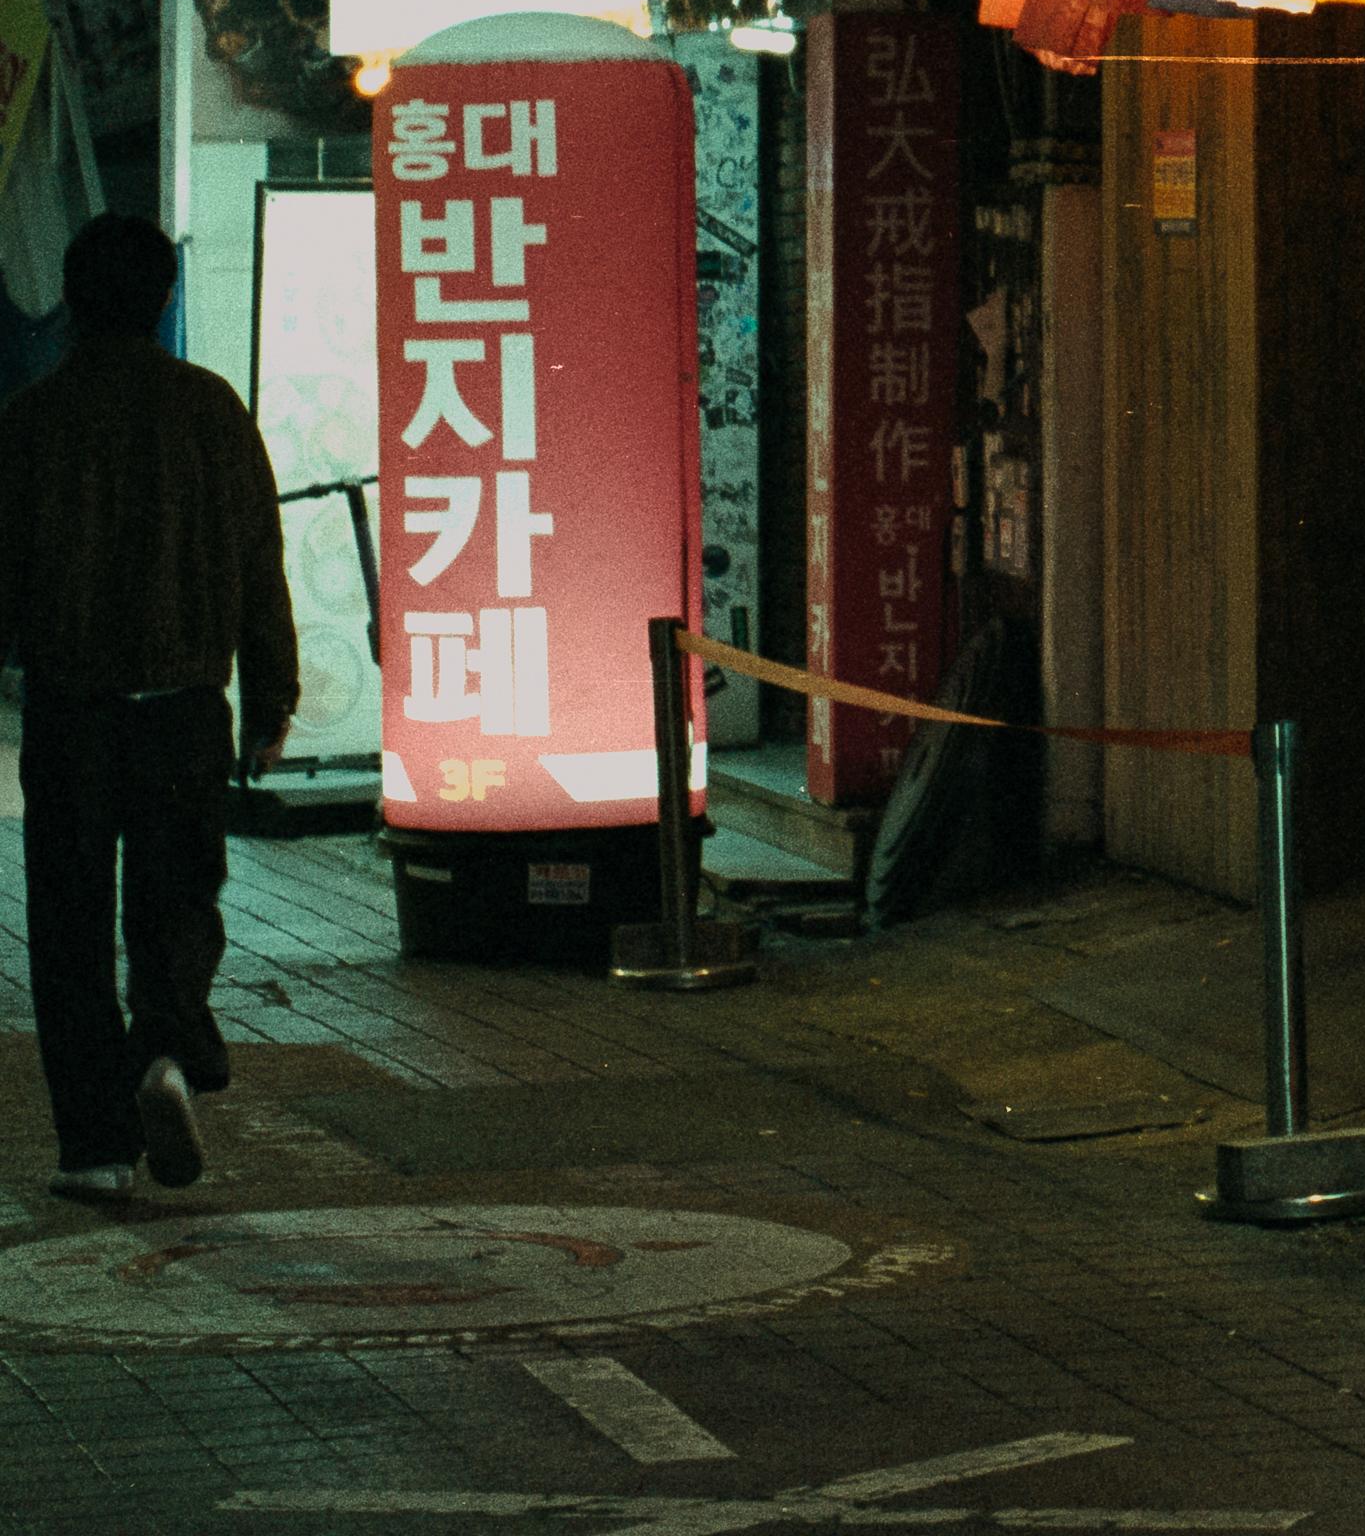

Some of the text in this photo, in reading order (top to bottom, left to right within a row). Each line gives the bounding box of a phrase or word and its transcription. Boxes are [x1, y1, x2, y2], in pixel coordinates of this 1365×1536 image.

[387, 98, 559, 182] 홍대
[864, 33, 937, 484] 弘大戒指制作
[400, 196, 557, 738] 반지카페
[872, 504, 933, 547] 홍대
[438, 758, 507, 802] 3F
